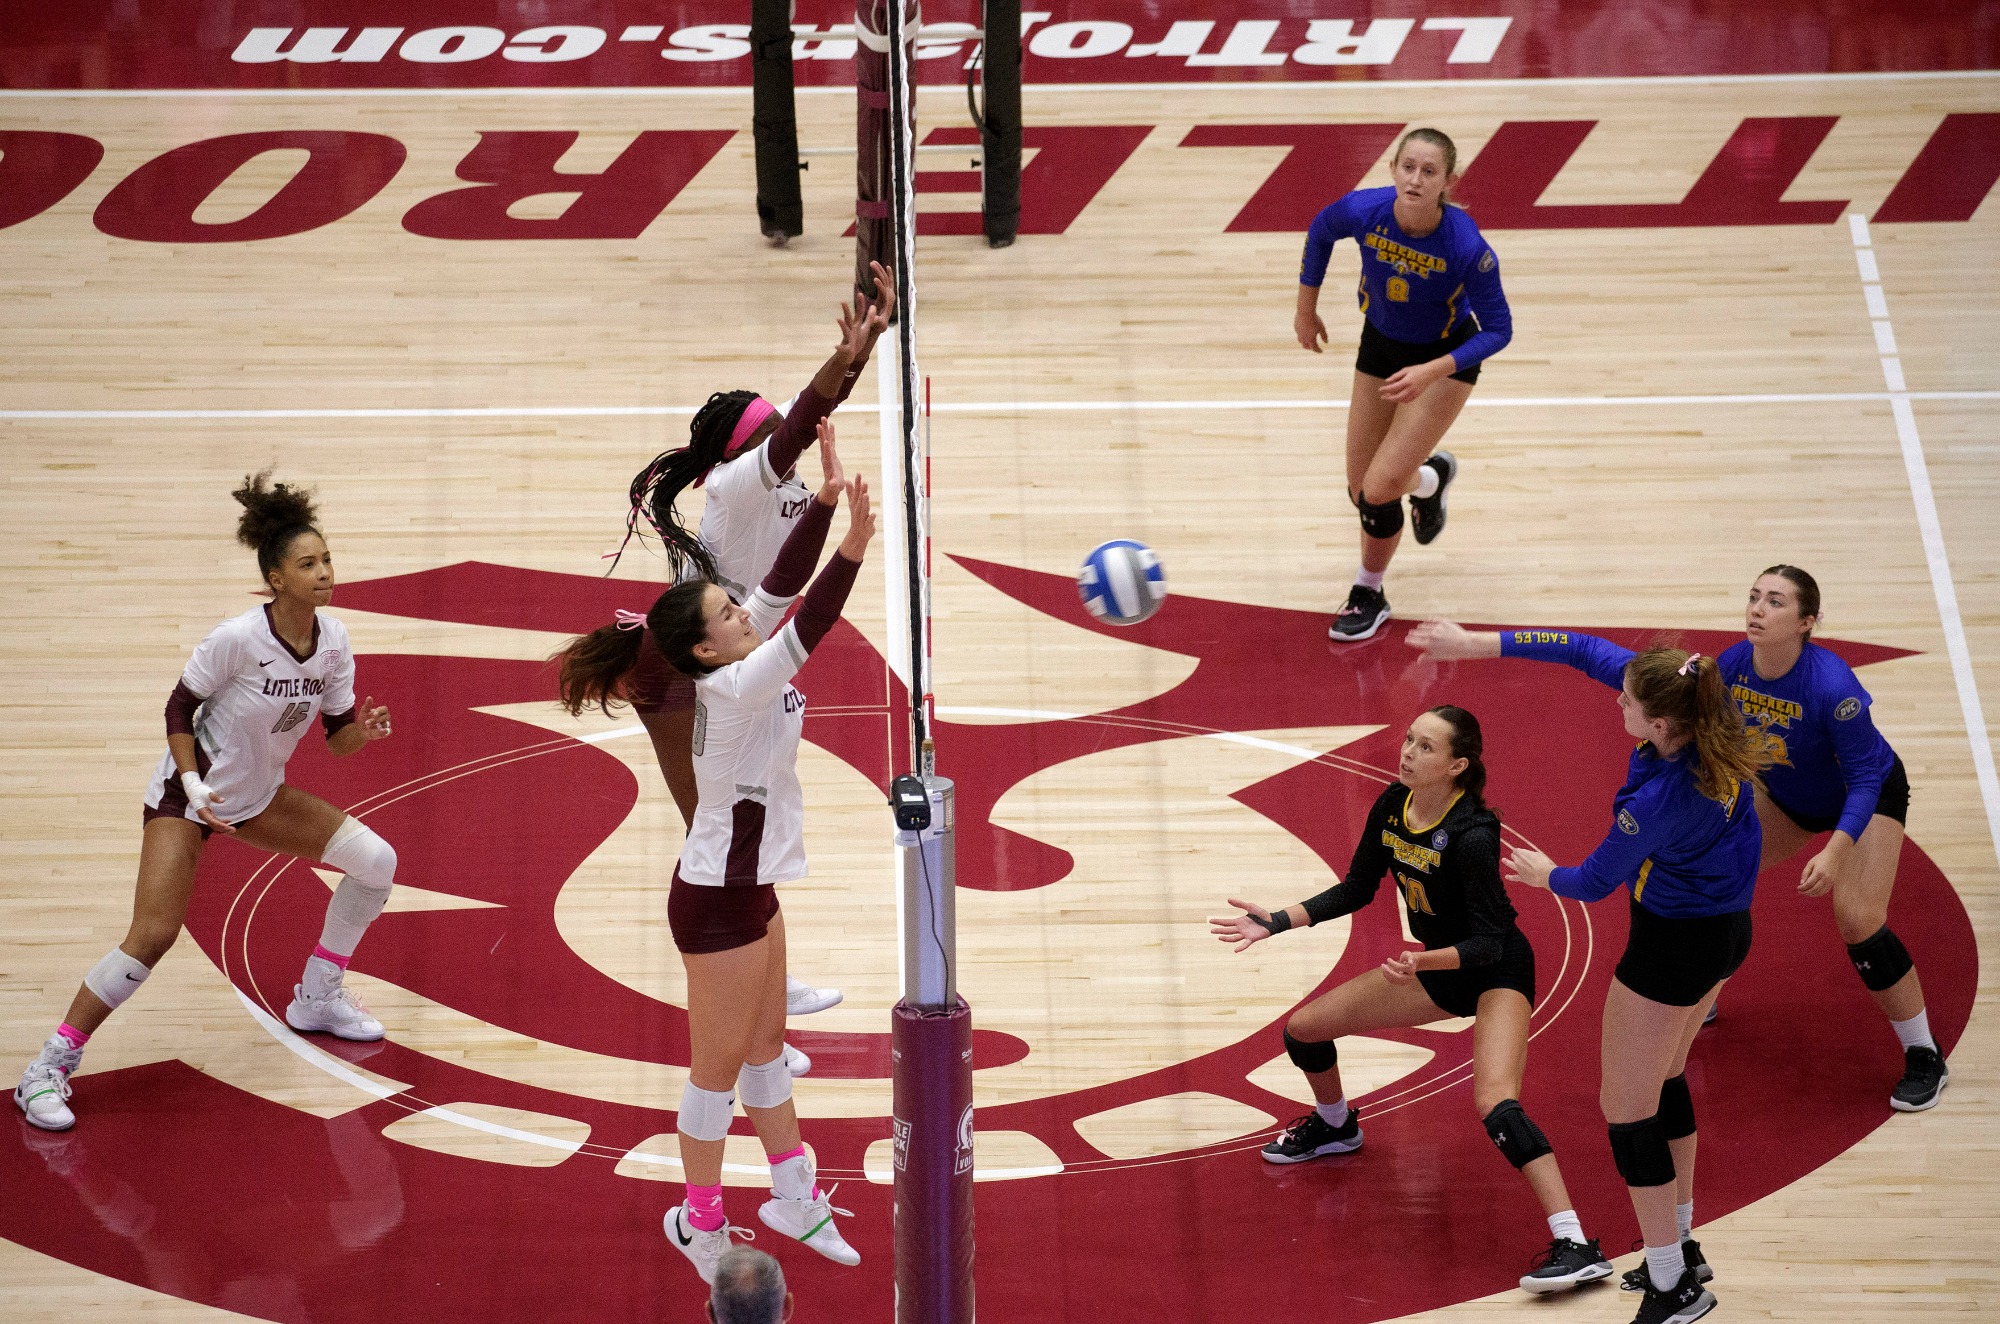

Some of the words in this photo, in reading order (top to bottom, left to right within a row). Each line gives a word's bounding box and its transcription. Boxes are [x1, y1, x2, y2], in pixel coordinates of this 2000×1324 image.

[1365, 232, 1447, 273] MOREHEAD
[1376, 249, 1430, 279] STATE
[1514, 631, 1568, 644] EAGLES
[262, 678, 300, 697] LITTLE
[271, 701, 311, 734] 15
[1742, 702, 1789, 728] STATE
[1382, 830, 1441, 867] MOREHEAD
[1394, 849, 1430, 873] STATE
